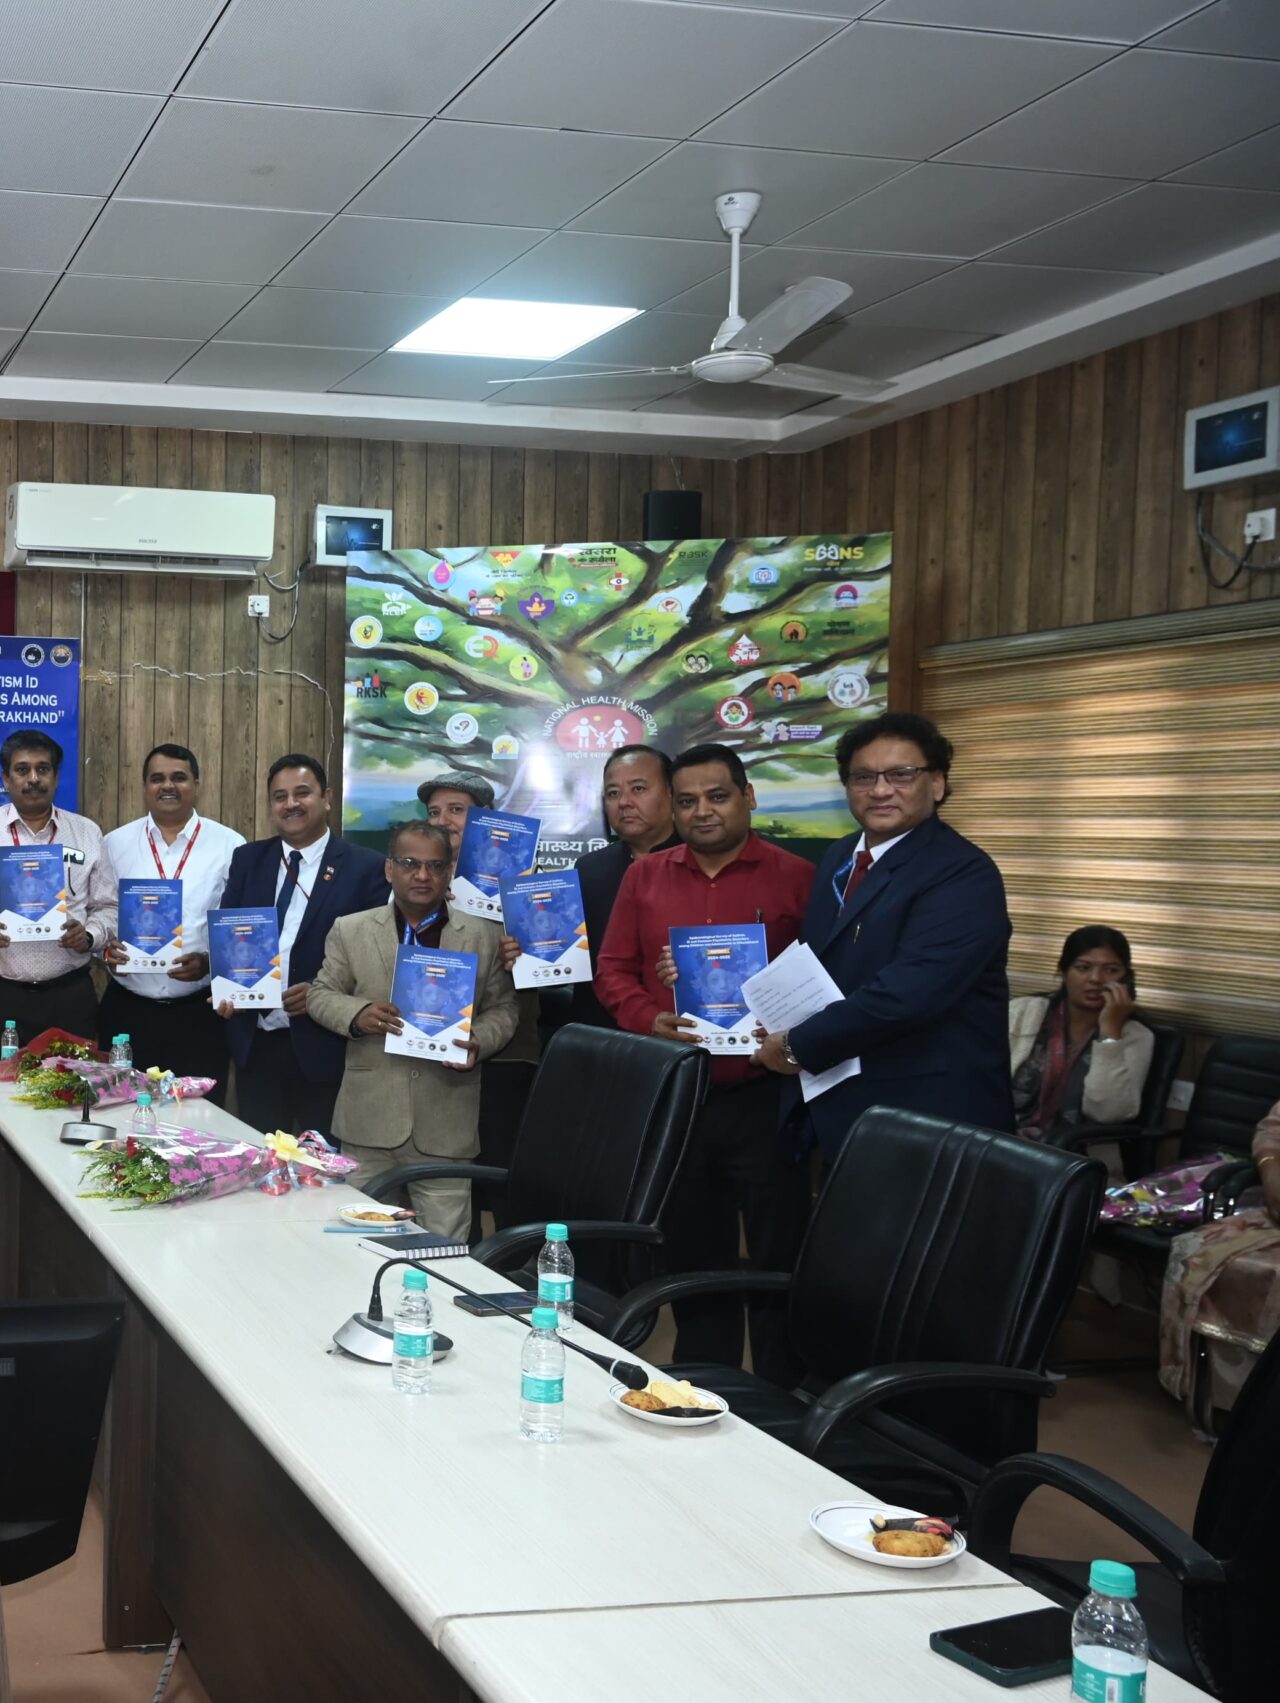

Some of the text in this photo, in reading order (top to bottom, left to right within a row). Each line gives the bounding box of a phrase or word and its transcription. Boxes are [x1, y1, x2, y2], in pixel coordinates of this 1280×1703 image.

[356, 687, 387, 698] RKSK
[542, 695, 658, 737] NATIONAL HEALTH MISSION
